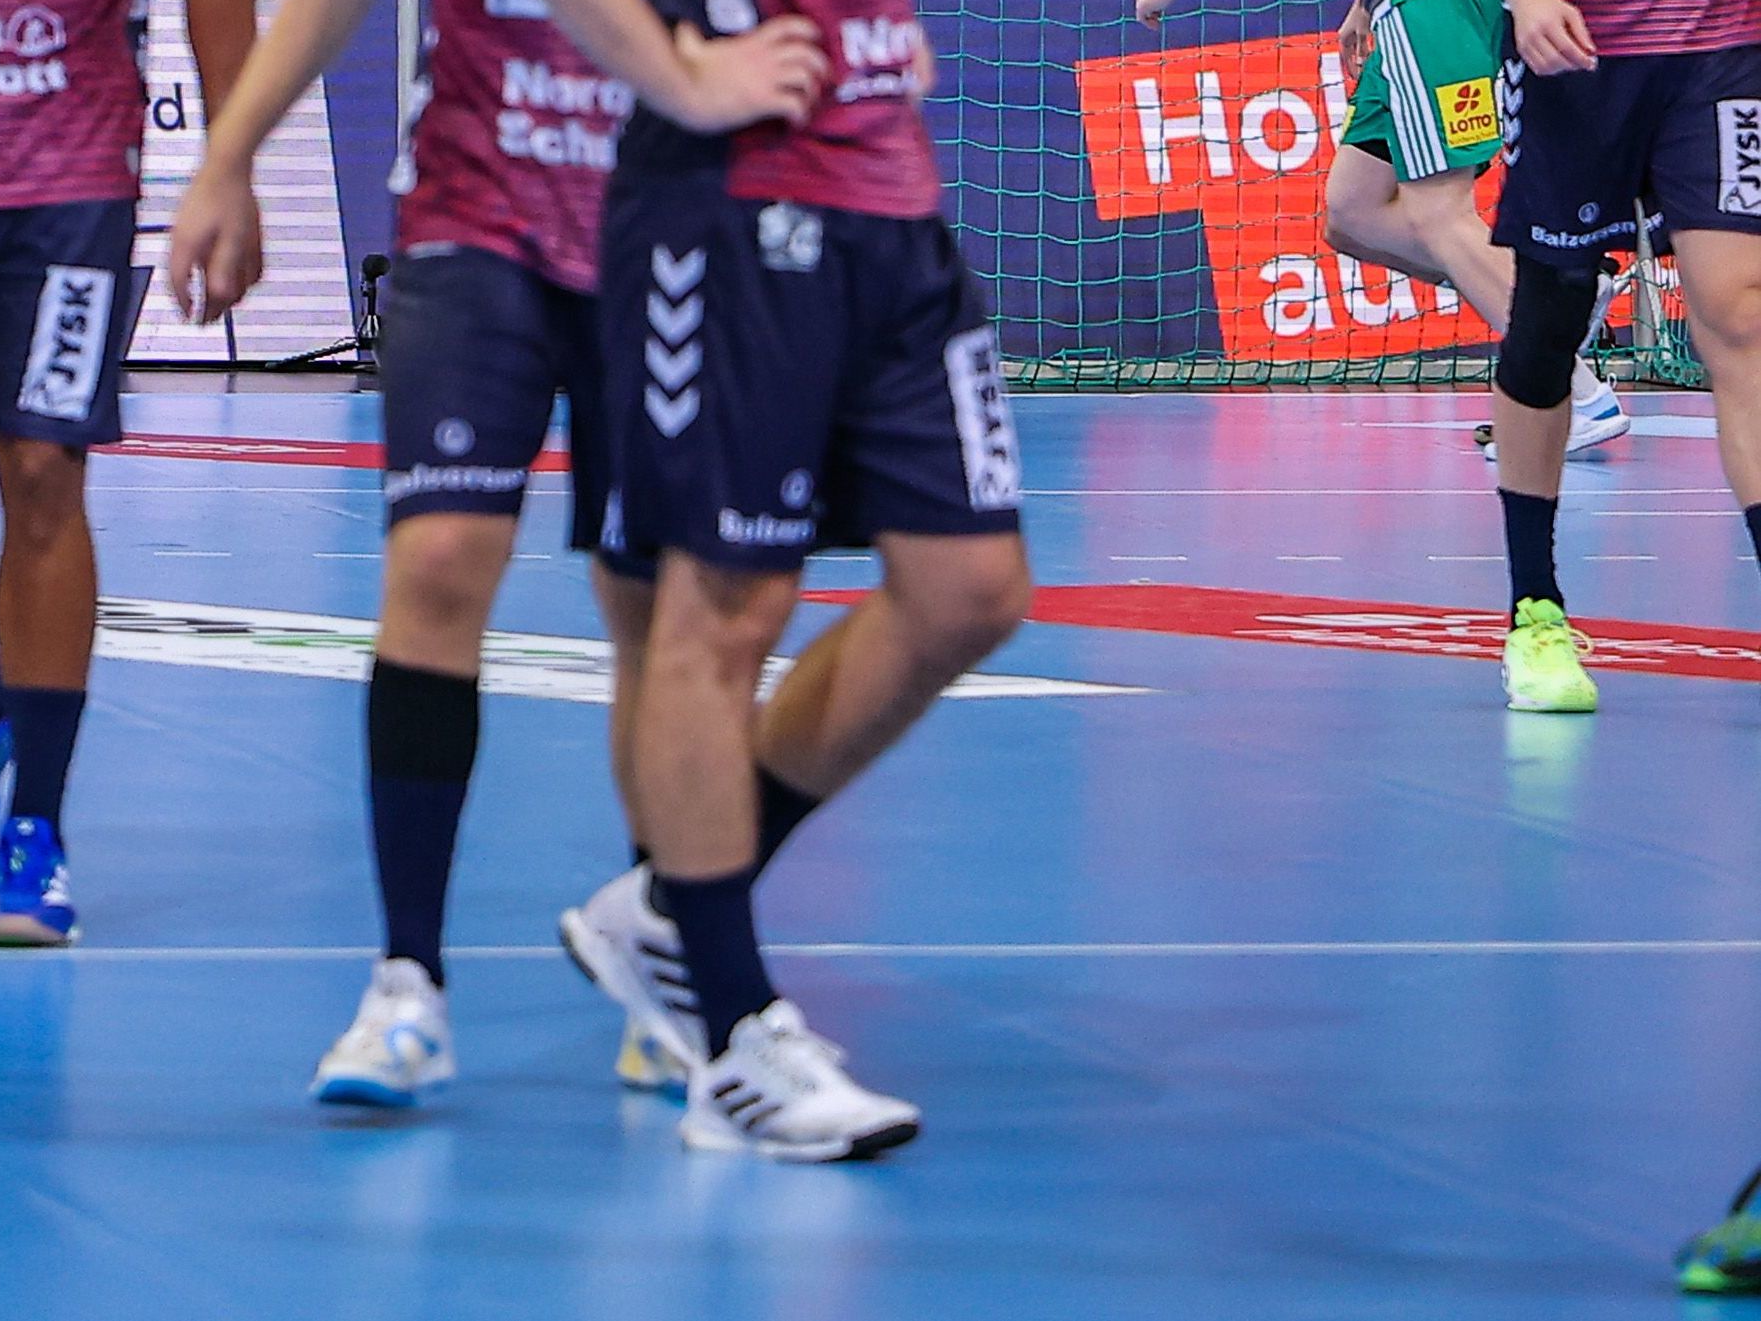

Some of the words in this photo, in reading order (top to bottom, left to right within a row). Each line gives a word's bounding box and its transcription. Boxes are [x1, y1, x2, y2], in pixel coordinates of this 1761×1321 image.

[1449, 113, 1493, 135] LOTTO
[1733, 106, 1761, 189] JYSK
[46, 278, 94, 384] JYSK
